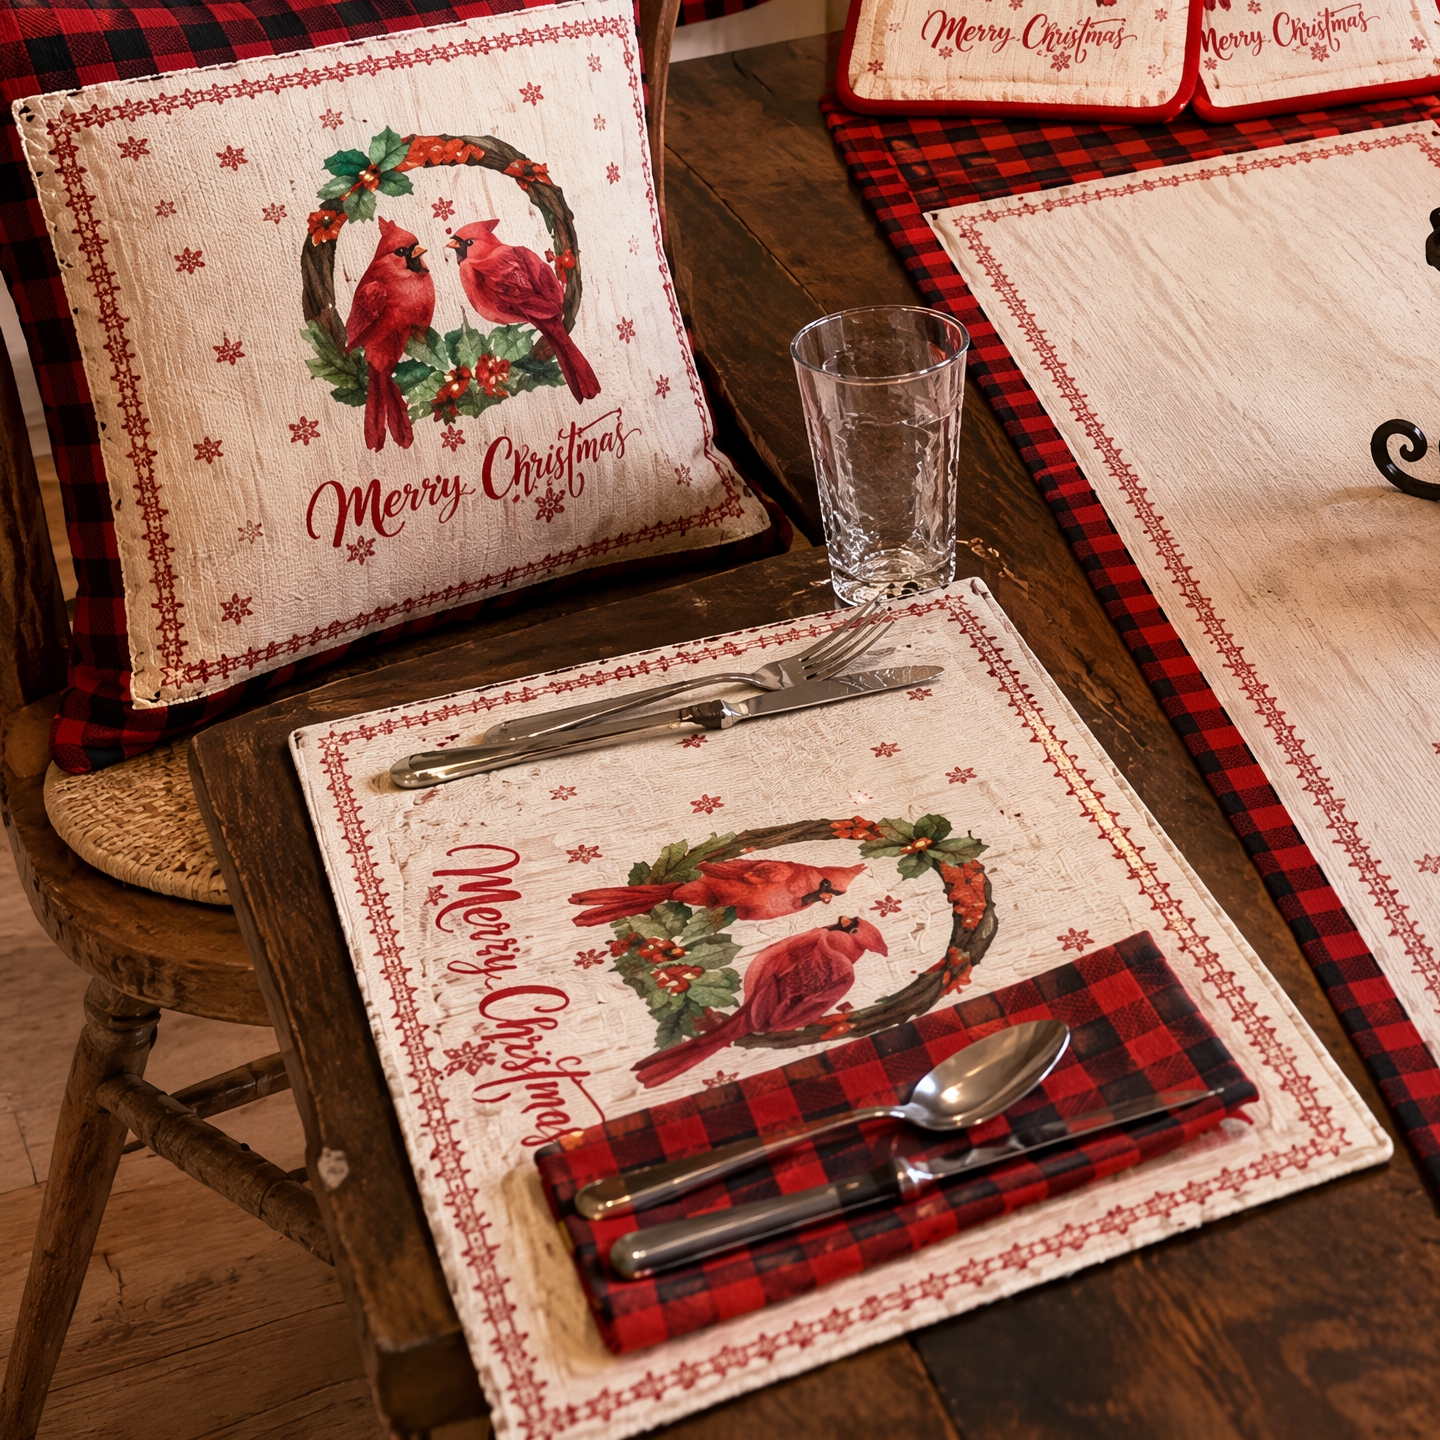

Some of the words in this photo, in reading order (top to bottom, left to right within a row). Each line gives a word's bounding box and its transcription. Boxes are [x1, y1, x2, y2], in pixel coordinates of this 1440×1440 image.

[921, 9, 1016, 54] Merry
[1022, 13, 1138, 64] Christmas
[1272, 3, 1381, 53] Christmas
[306, 475, 476, 548] Merry
[482, 408, 642, 499] Christmas
[432, 843, 522, 990] Merry
